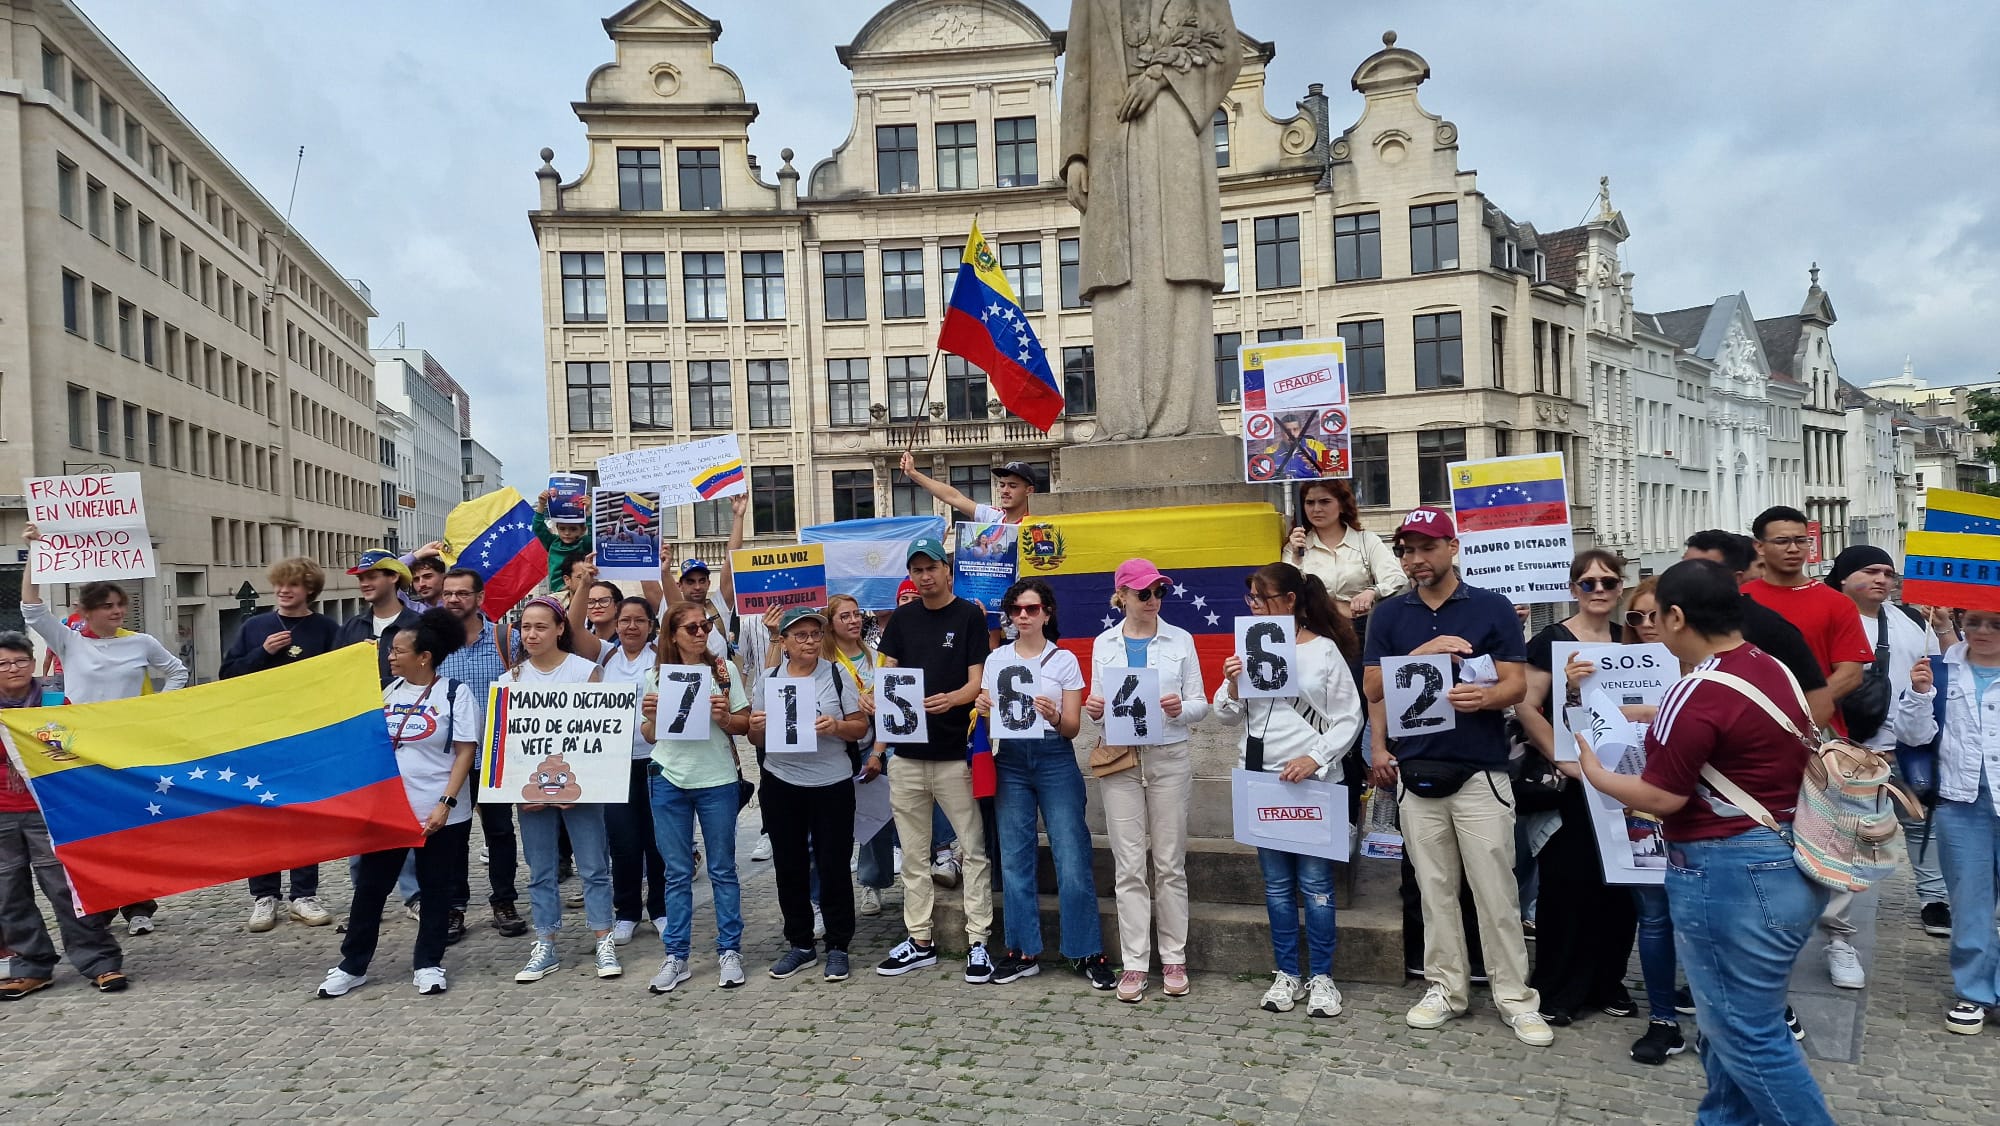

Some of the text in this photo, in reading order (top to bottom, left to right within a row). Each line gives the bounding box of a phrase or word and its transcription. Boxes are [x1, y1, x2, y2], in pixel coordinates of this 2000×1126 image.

[1280, 372, 1326, 391] FRAUDE
[622, 453, 634, 461] NOT
[599, 463, 623, 472] RIGHT
[30, 477, 115, 500] FRAUDE
[36, 497, 138, 521] EN VENEZUELA
[1404, 510, 1437, 526] UCV
[40, 531, 130, 550] SOLDADO
[1464, 537, 1567, 555] MADURO DICTADOR
[36, 548, 145, 573] DESPIERTA
[751, 551, 809, 567] ALZA LA VOZ
[1504, 564, 1515, 572] DE
[1515, 584, 1526, 593] DE
[745, 591, 817, 608] POR VENEZUELA
[1245, 621, 1289, 691] 6
[1601, 654, 1660, 670] S.O.S.
[1601, 679, 1662, 690] VENEZUELA
[509, 691, 636, 710] MADURO DICTADOR
[666, 671, 702, 734] 7
[882, 674, 919, 735] 5
[997, 664, 1037, 731] 6
[1395, 662, 1447, 730] 2
[778, 684, 799, 745] 1
[1111, 674, 1148, 737] 4
[508, 718, 540, 734] HIJO
[545, 719, 562, 734] DE
[521, 737, 552, 755] VETE
[584, 738, 602, 753] LA
[1263, 808, 1315, 819] FRAUDE
